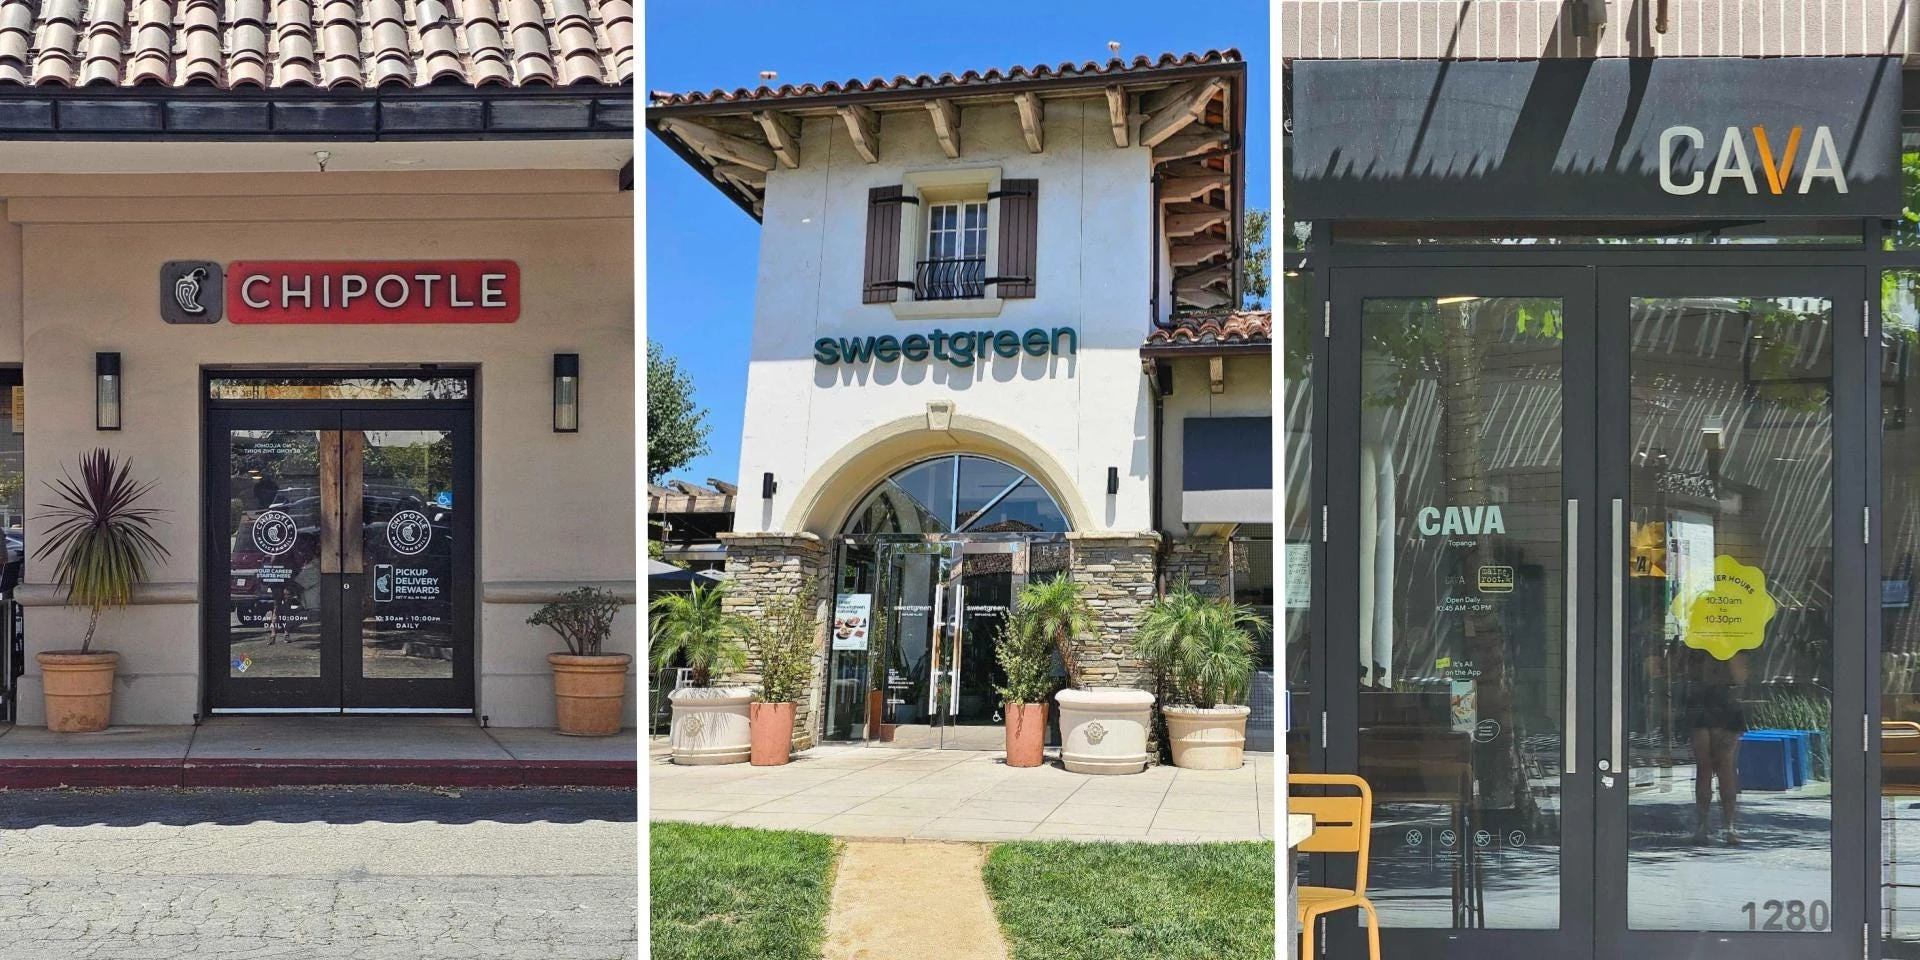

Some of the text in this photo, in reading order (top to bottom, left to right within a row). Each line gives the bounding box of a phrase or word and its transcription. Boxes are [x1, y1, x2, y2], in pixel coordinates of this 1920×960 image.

[1659, 124, 1849, 195] CAVA
[241, 274, 507, 309] CHIPOTLE
[814, 326, 1078, 368] sweetgreen
[257, 513, 293, 530] CHIPOTLE
[391, 513, 428, 530] CHIPOTLE
[1418, 505, 1506, 536] CAVA
[395, 568, 428, 576] PICKUP
[395, 577, 439, 585] DELIVERY
[1728, 575, 1755, 595] HOURS
[395, 586, 440, 594] REWARDS
[1465, 596, 1481, 604] Daily
[1705, 596, 1742, 605] 10:30am
[1705, 615, 1742, 624] 10:30pm
[1467, 669, 1481, 677] App
[1741, 899, 1829, 931] 1280
